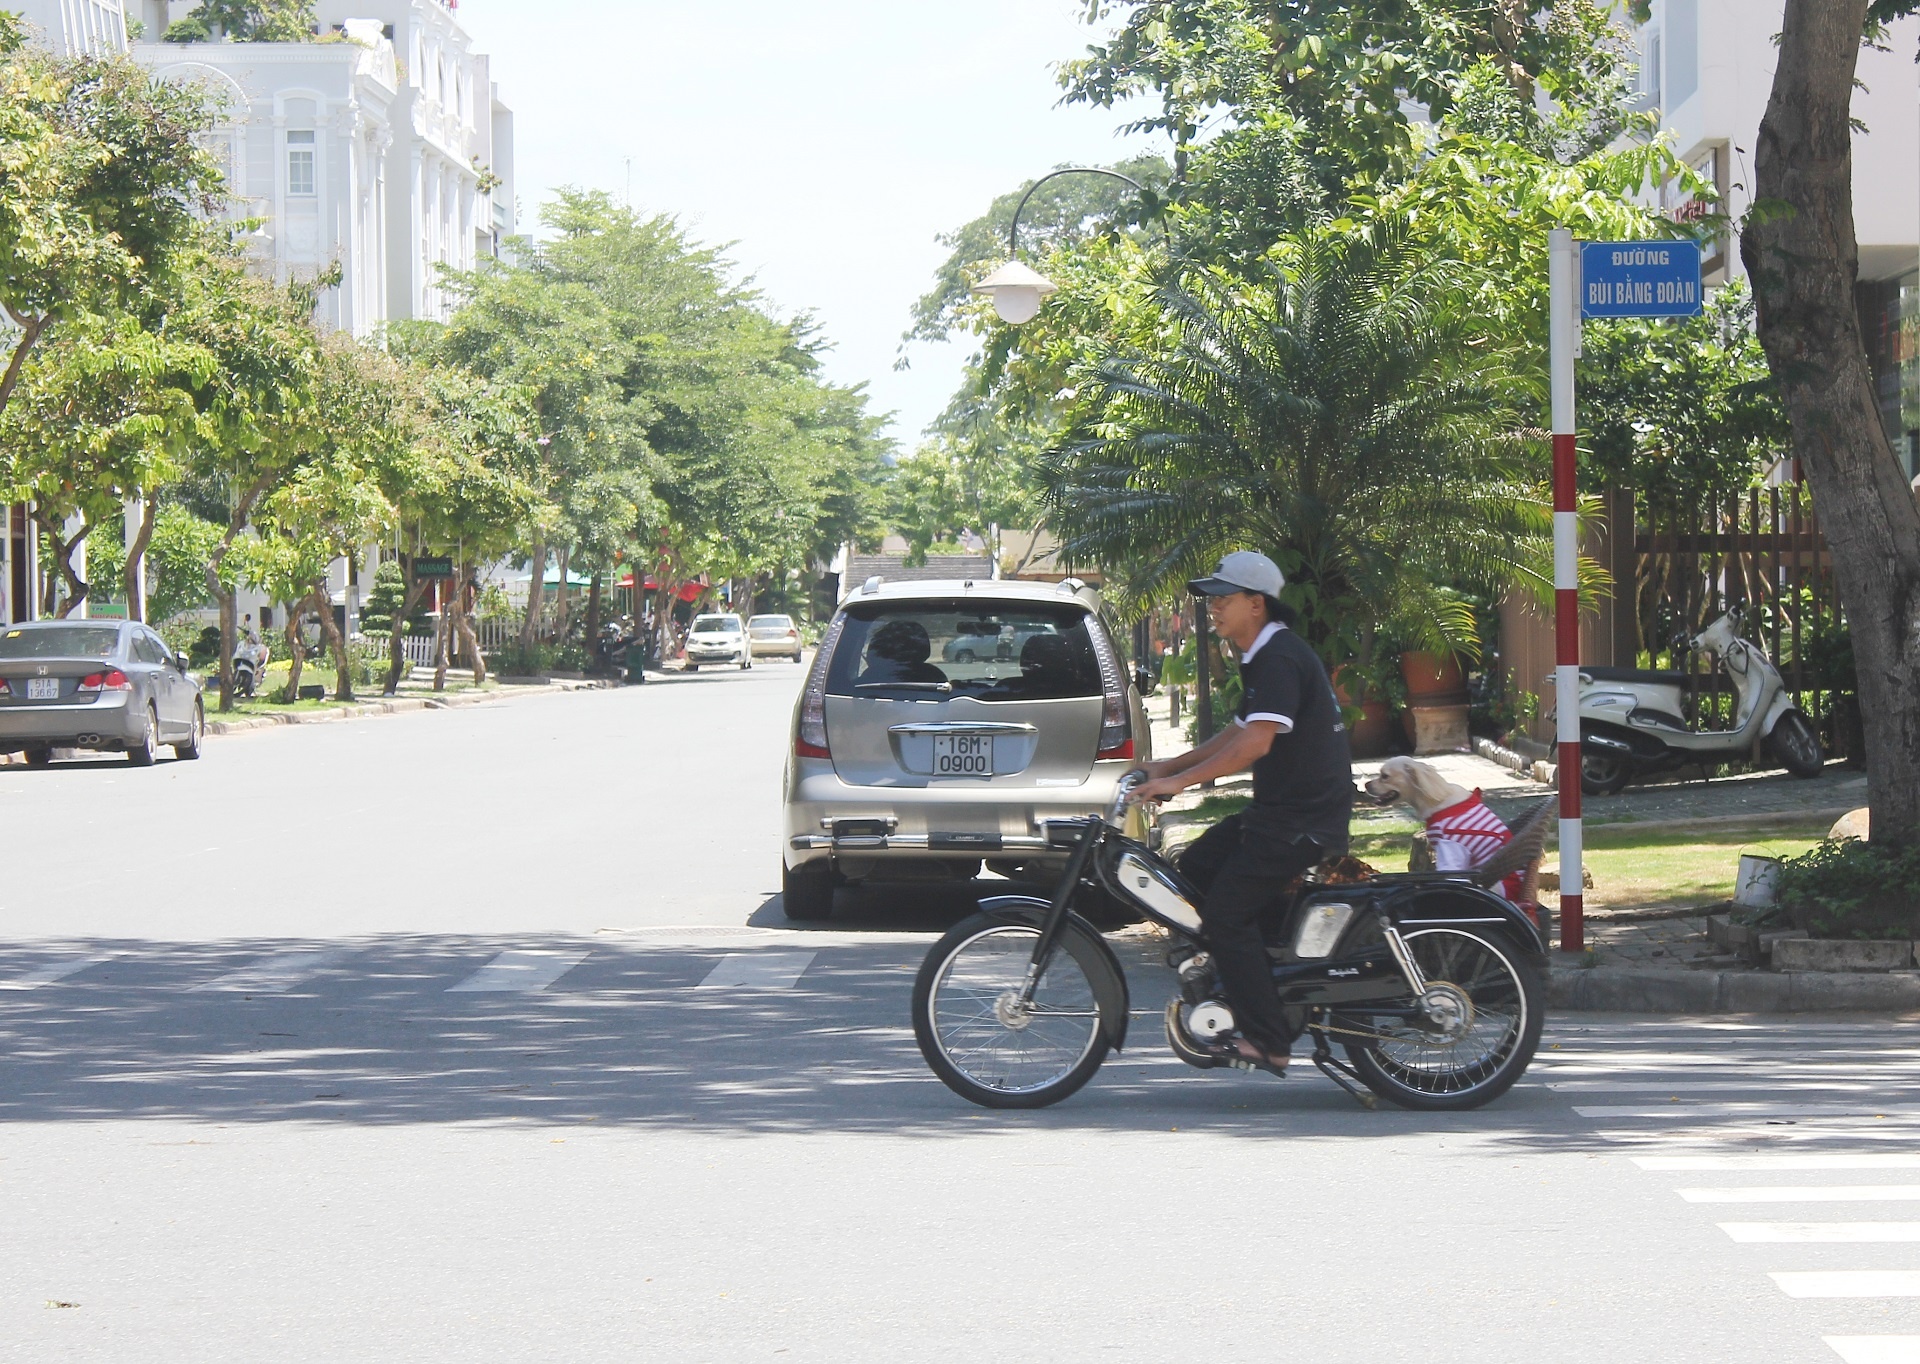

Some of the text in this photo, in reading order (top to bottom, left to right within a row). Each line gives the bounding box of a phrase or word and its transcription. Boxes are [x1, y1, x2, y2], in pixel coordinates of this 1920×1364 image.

[1611, 247, 1670, 266] ĐƯỜNG
[1589, 273, 1695, 304] BÙI BẰNG ĐOÀN
[416, 563, 450, 574] MASSAGE
[35, 679, 52, 688] 51A
[949, 736, 981, 754] 16M
[940, 755, 986, 772] 0900
